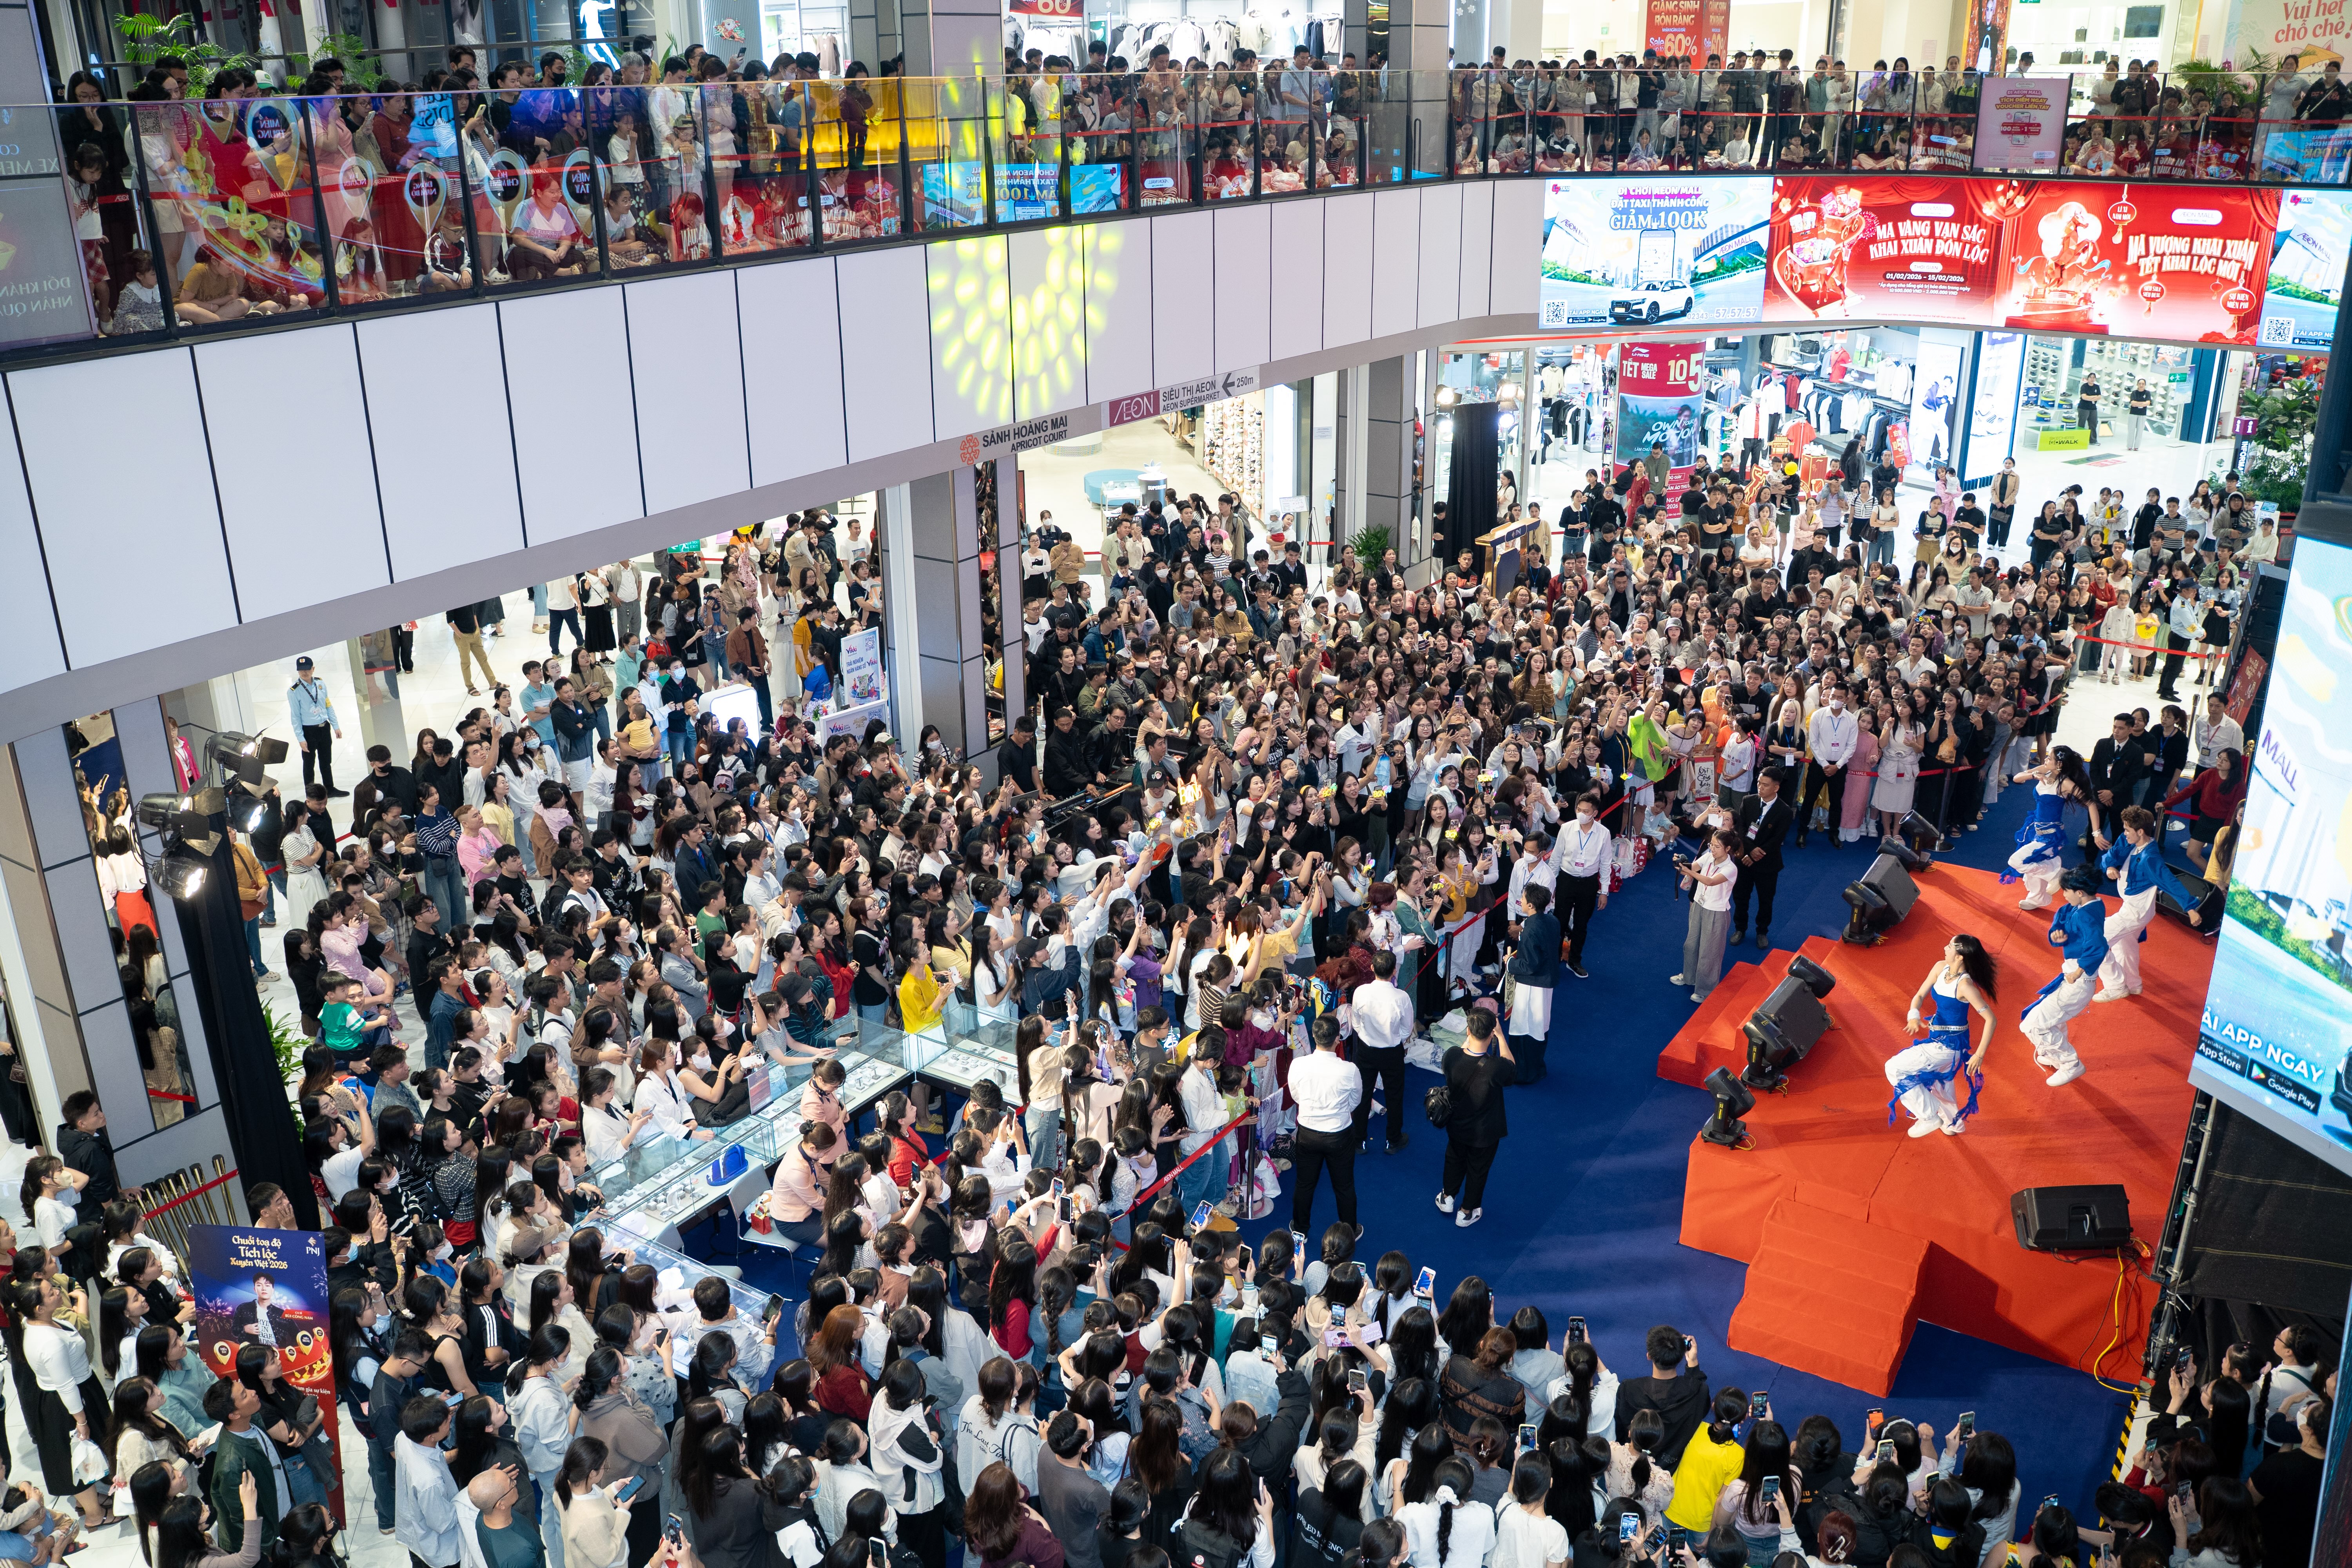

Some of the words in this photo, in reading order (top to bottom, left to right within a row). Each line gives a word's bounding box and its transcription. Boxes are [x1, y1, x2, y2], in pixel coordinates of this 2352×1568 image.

[1679, 0, 1700, 13] SINH
[2283, 0, 2312, 21] Vui
[1673, 13, 1695, 26] RÀNG
[2275, 19, 2308, 43] chỗ
[1650, 37, 1664, 47] Sale
[1664, 33, 1697, 57] 60%
[1618, 187, 1627, 195] ĐI
[1629, 185, 1652, 195] CHƠI
[1653, 186, 1678, 195] AEON
[1679, 186, 1703, 195] MALL
[1610, 197, 1629, 211] ĐẶT
[1630, 198, 1650, 208] TAXI
[1651, 196, 1684, 207] THÀNH
[1684, 196, 1709, 207] CÔNG
[1610, 209, 1652, 230] GIẢM
[1659, 211, 1708, 229] 100K
[1876, 221, 1895, 240] MÃ
[1898, 219, 1931, 237] VÀNG
[1934, 220, 1960, 240] VẠN
[1734, 234, 1753, 248] MALL
[1869, 240, 1898, 260] KHAI
[1900, 236, 1934, 255] XUÂN
[1935, 239, 1963, 256] ĐÓN
[1962, 243, 1990, 263] LỘC
[2126, 234, 2146, 265] MÃ
[2149, 234, 2190, 257] VƯỢNG
[2192, 237, 2224, 258] KHAI
[2222, 237, 2259, 271] XUÂN
[2318, 245, 2331, 261] MALL
[2138, 252, 2161, 277] TẾT
[2161, 255, 2191, 272] KHAI
[2191, 255, 2216, 275] LỘC
[2216, 259, 2241, 282] MỚI
[1714, 307, 1758, 319] 57.57.57
[1622, 358, 1639, 378] TẾT
[1641, 363, 1657, 372] MEGA
[1668, 359, 1688, 381] 10
[1641, 371, 1656, 379] SALE
[1162, 387, 1180, 401] SIÊU
[1181, 385, 1194, 400] THỊ
[1195, 379, 1216, 394] AEON
[1236, 375, 1254, 388] 250m
[1162, 401, 1178, 412] AEON
[1179, 390, 1220, 409] SUPERMARKET
[982, 427, 1010, 448] SẢNH
[1013, 419, 1049, 440] HOÀNG
[1050, 414, 1068, 430] MAI
[1642, 425, 1696, 444] MOTION
[1651, 418, 1683, 432] OWN
[1010, 436, 1043, 453] APRICOT
[1043, 429, 1068, 445] COURT
[846, 644, 857, 655] Vikki
[853, 657, 864, 666] NGHIỆM
[867, 657, 877, 667] Vikki
[829, 722, 844, 733] Vikki
[2261, 728, 2298, 791] MALL
[2199, 1042, 2217, 1060] App
[2218, 1053, 2241, 1071] Store
[2222, 1022, 2262, 1049] APP
[2267, 1043, 2324, 1082] NGAY
[2267, 1078, 2297, 1100] Google
[2298, 1094, 2316, 1111] Play
[1171, 1165, 1184, 1176] MALL
[232, 1235, 255, 1245] Chuỗi
[256, 1238, 270, 1247] toạ
[270, 1238, 281, 1249] độ
[306, 1247, 320, 1256] PNJ
[230, 1257, 253, 1268] Xuyên
[255, 1259, 269, 1269] Việt
[269, 1260, 288, 1269] 2026
[238, 1246, 260, 1258] Tích
[262, 1248, 278, 1261] lộc
[961, 1421, 973, 1435] The
[973, 1430, 989, 1448] Last
[1297, 1512, 1316, 1534] FABLED
